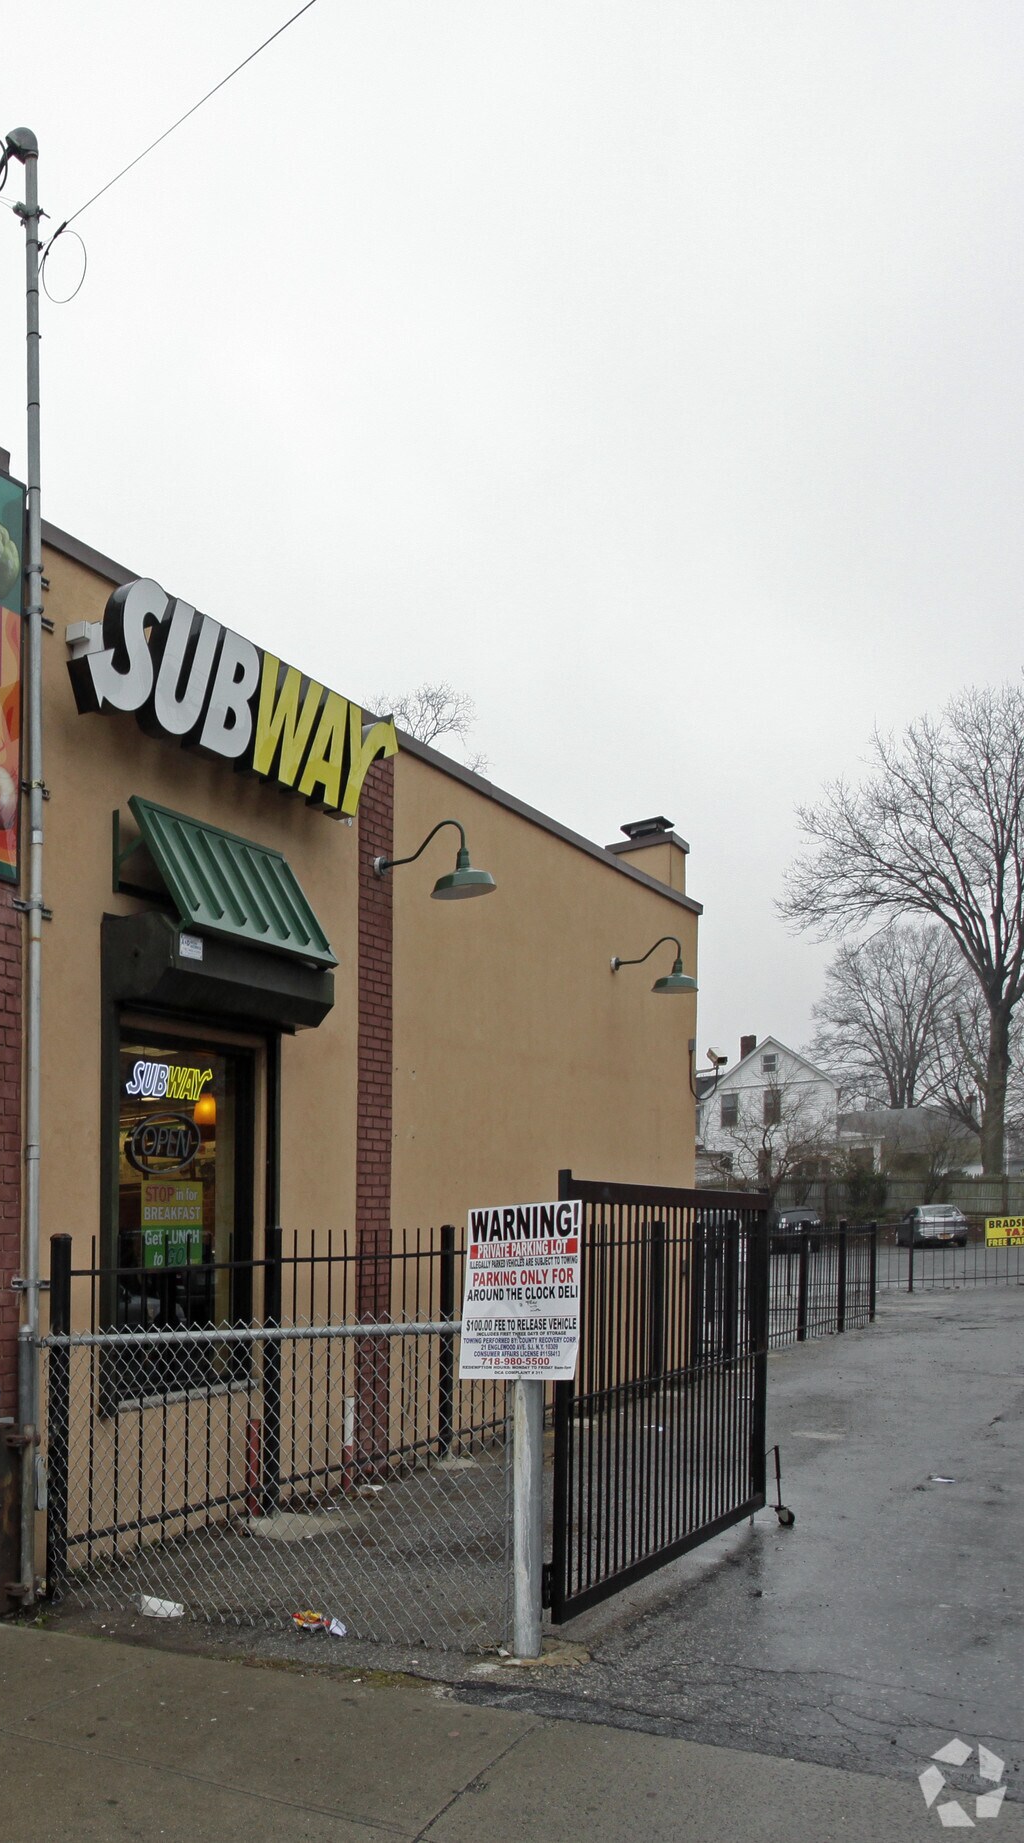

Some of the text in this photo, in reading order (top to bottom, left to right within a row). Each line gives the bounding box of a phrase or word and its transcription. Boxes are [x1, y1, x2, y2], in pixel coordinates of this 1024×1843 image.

[86, 577, 399, 817] SUBWAY
[126, 1061, 213, 1101] SUBWAY
[141, 1125, 193, 1158] OPEN
[146, 1185, 198, 1203] STOP in for
[144, 1206, 201, 1220] BREAKFAST
[471, 1202, 579, 1243] WARNING!
[145, 1230, 163, 1245] Get
[988, 1238, 1008, 1246] FREE
[477, 1239, 568, 1259] PRIVATE PARKING LOT
[153, 1252, 164, 1266] to
[469, 1260, 492, 1269] ILLEGALLY
[492, 1259, 506, 1268] PARKED
[506, 1258, 525, 1267] VEHICLES
[525, 1257, 534, 1266] ARE
[534, 1256, 554, 1266] SUBJECT
[561, 1255, 578, 1264] TOWING
[472, 1267, 574, 1287] PARKING ONLY FOR
[467, 1285, 578, 1302] AROUND THE CLOCK DELI
[466, 1317, 577, 1332] $100.00 FEE TO RELEASE VEHICLE
[480, 1357, 550, 1366] 718-980-5500
